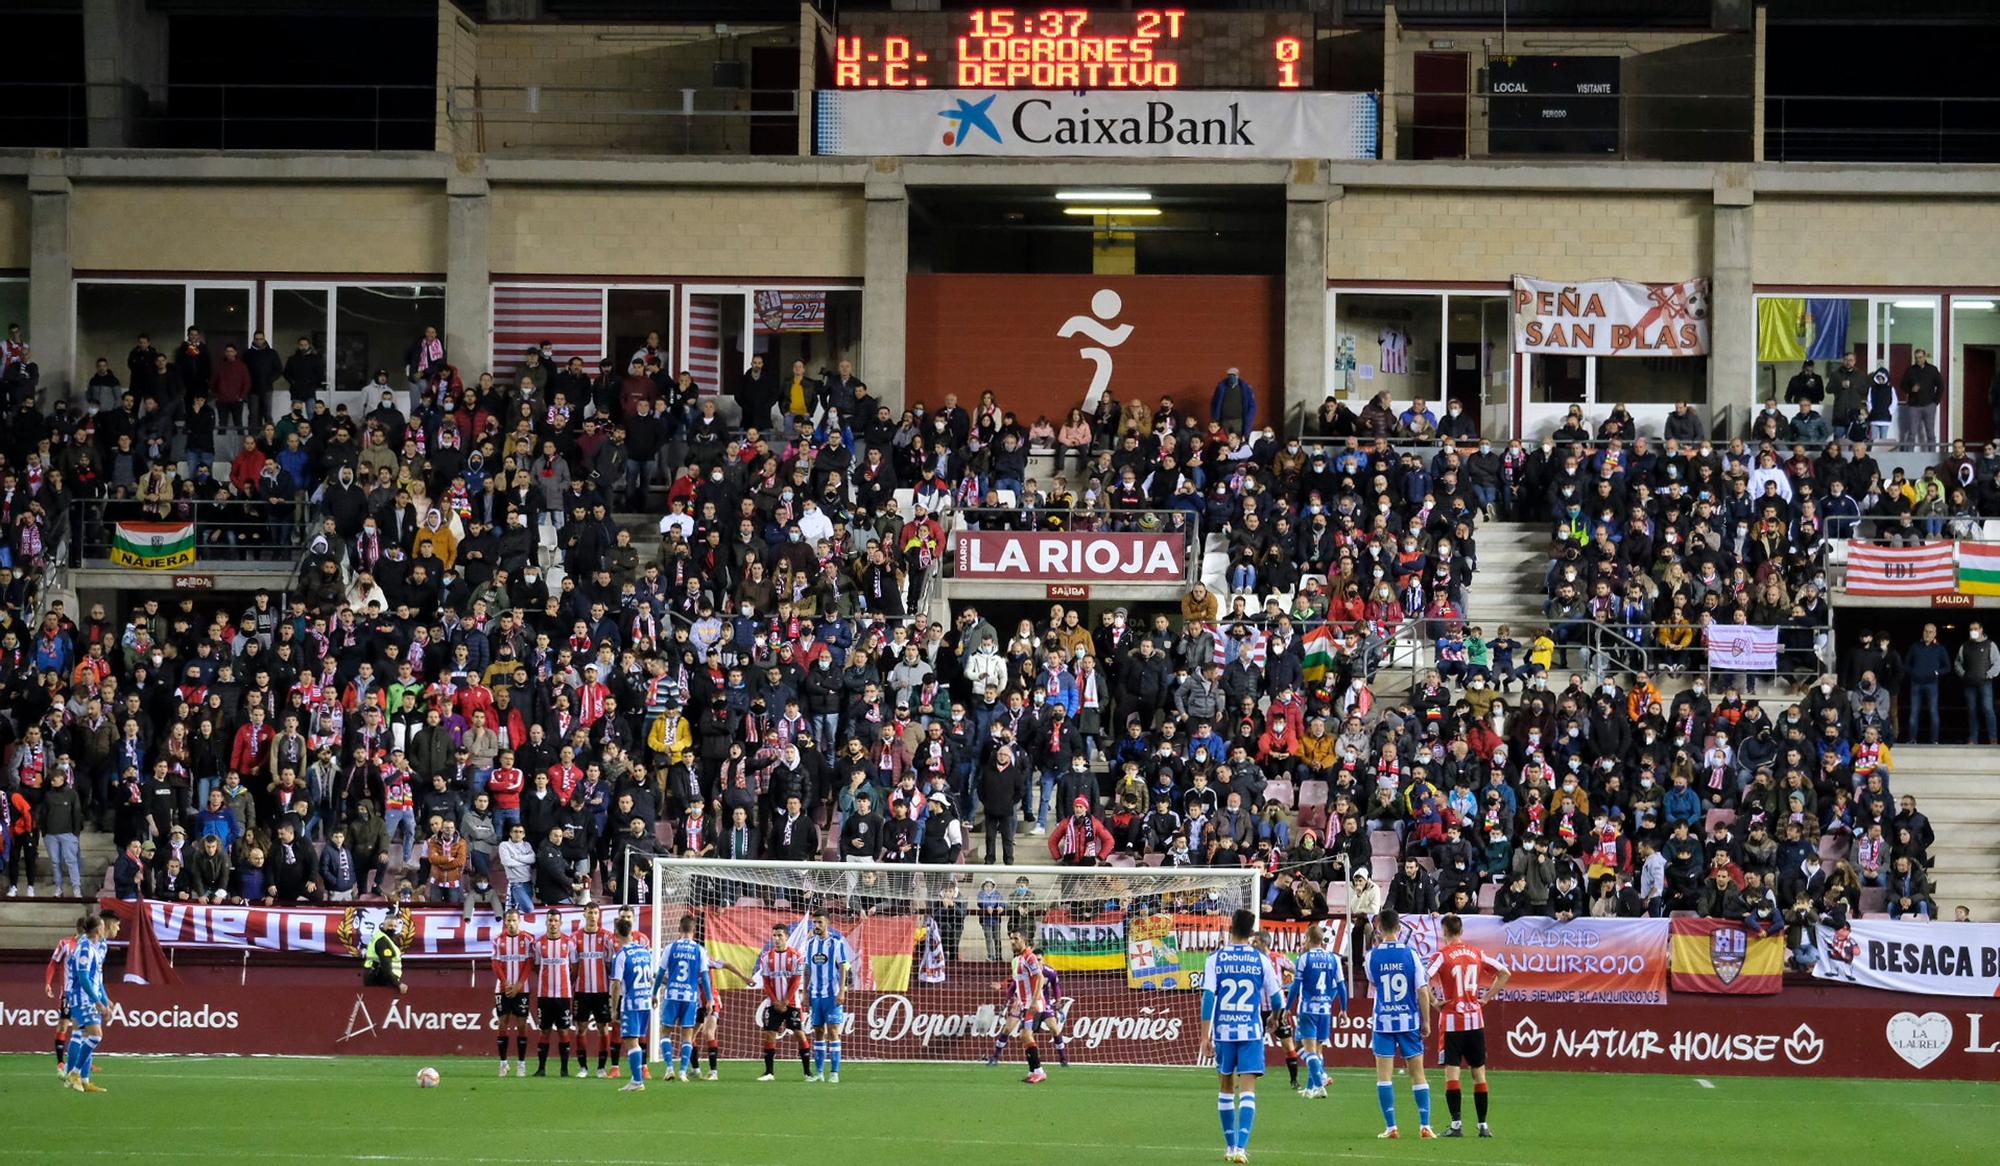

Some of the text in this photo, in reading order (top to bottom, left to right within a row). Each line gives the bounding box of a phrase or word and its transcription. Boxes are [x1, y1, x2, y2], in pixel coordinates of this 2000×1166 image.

[970, 10, 1185, 38] 15:37 2T
[837, 36, 928, 62] U.D.
[1276, 40, 1300, 62] 0
[837, 62, 1300, 87] R.C. DEPORTIVO 1
[1493, 83, 1611, 94] LOCAL VISITANTE
[1012, 98, 1255, 146] CaixaBank
[792, 302, 820, 320] 27
[1515, 286, 1606, 318] PEÑA
[1525, 321, 1698, 350] SAN BLAS
[959, 538, 968, 571] DIARIO
[970, 538, 1180, 575] LA RIOJA
[1884, 562, 1917, 579] UDL
[1935, 595, 1970, 604] SALIDA
[151, 904, 326, 951] VIEJO
[1505, 927, 1600, 949] MADRID
[676, 960, 689, 982] 3
[1380, 962, 1404, 971] JAIME
[1494, 952, 1645, 975] ANQUIRROJO
[1868, 940, 2000, 977] RESACA B
[1316, 971, 1327, 994] 4
[1380, 973, 1408, 1003] 19
[1451, 963, 1478, 998] 14
[1220, 978, 1255, 1012] 22
[1382, 1004, 1410, 1012] ABANCA
[1531, 988, 1575, 1002] SIEMPRE
[0, 1002, 61, 1028] lvare
[106, 1003, 240, 1029] Asociados
[383, 1000, 481, 1031] Álvarez
[1552, 1027, 1781, 1062] NATUR HOUSE
[1899, 1040, 1940, 1049] LAUREL
[1912, 1029, 1927, 1038] LA
[1963, 1013, 2000, 1053] L
